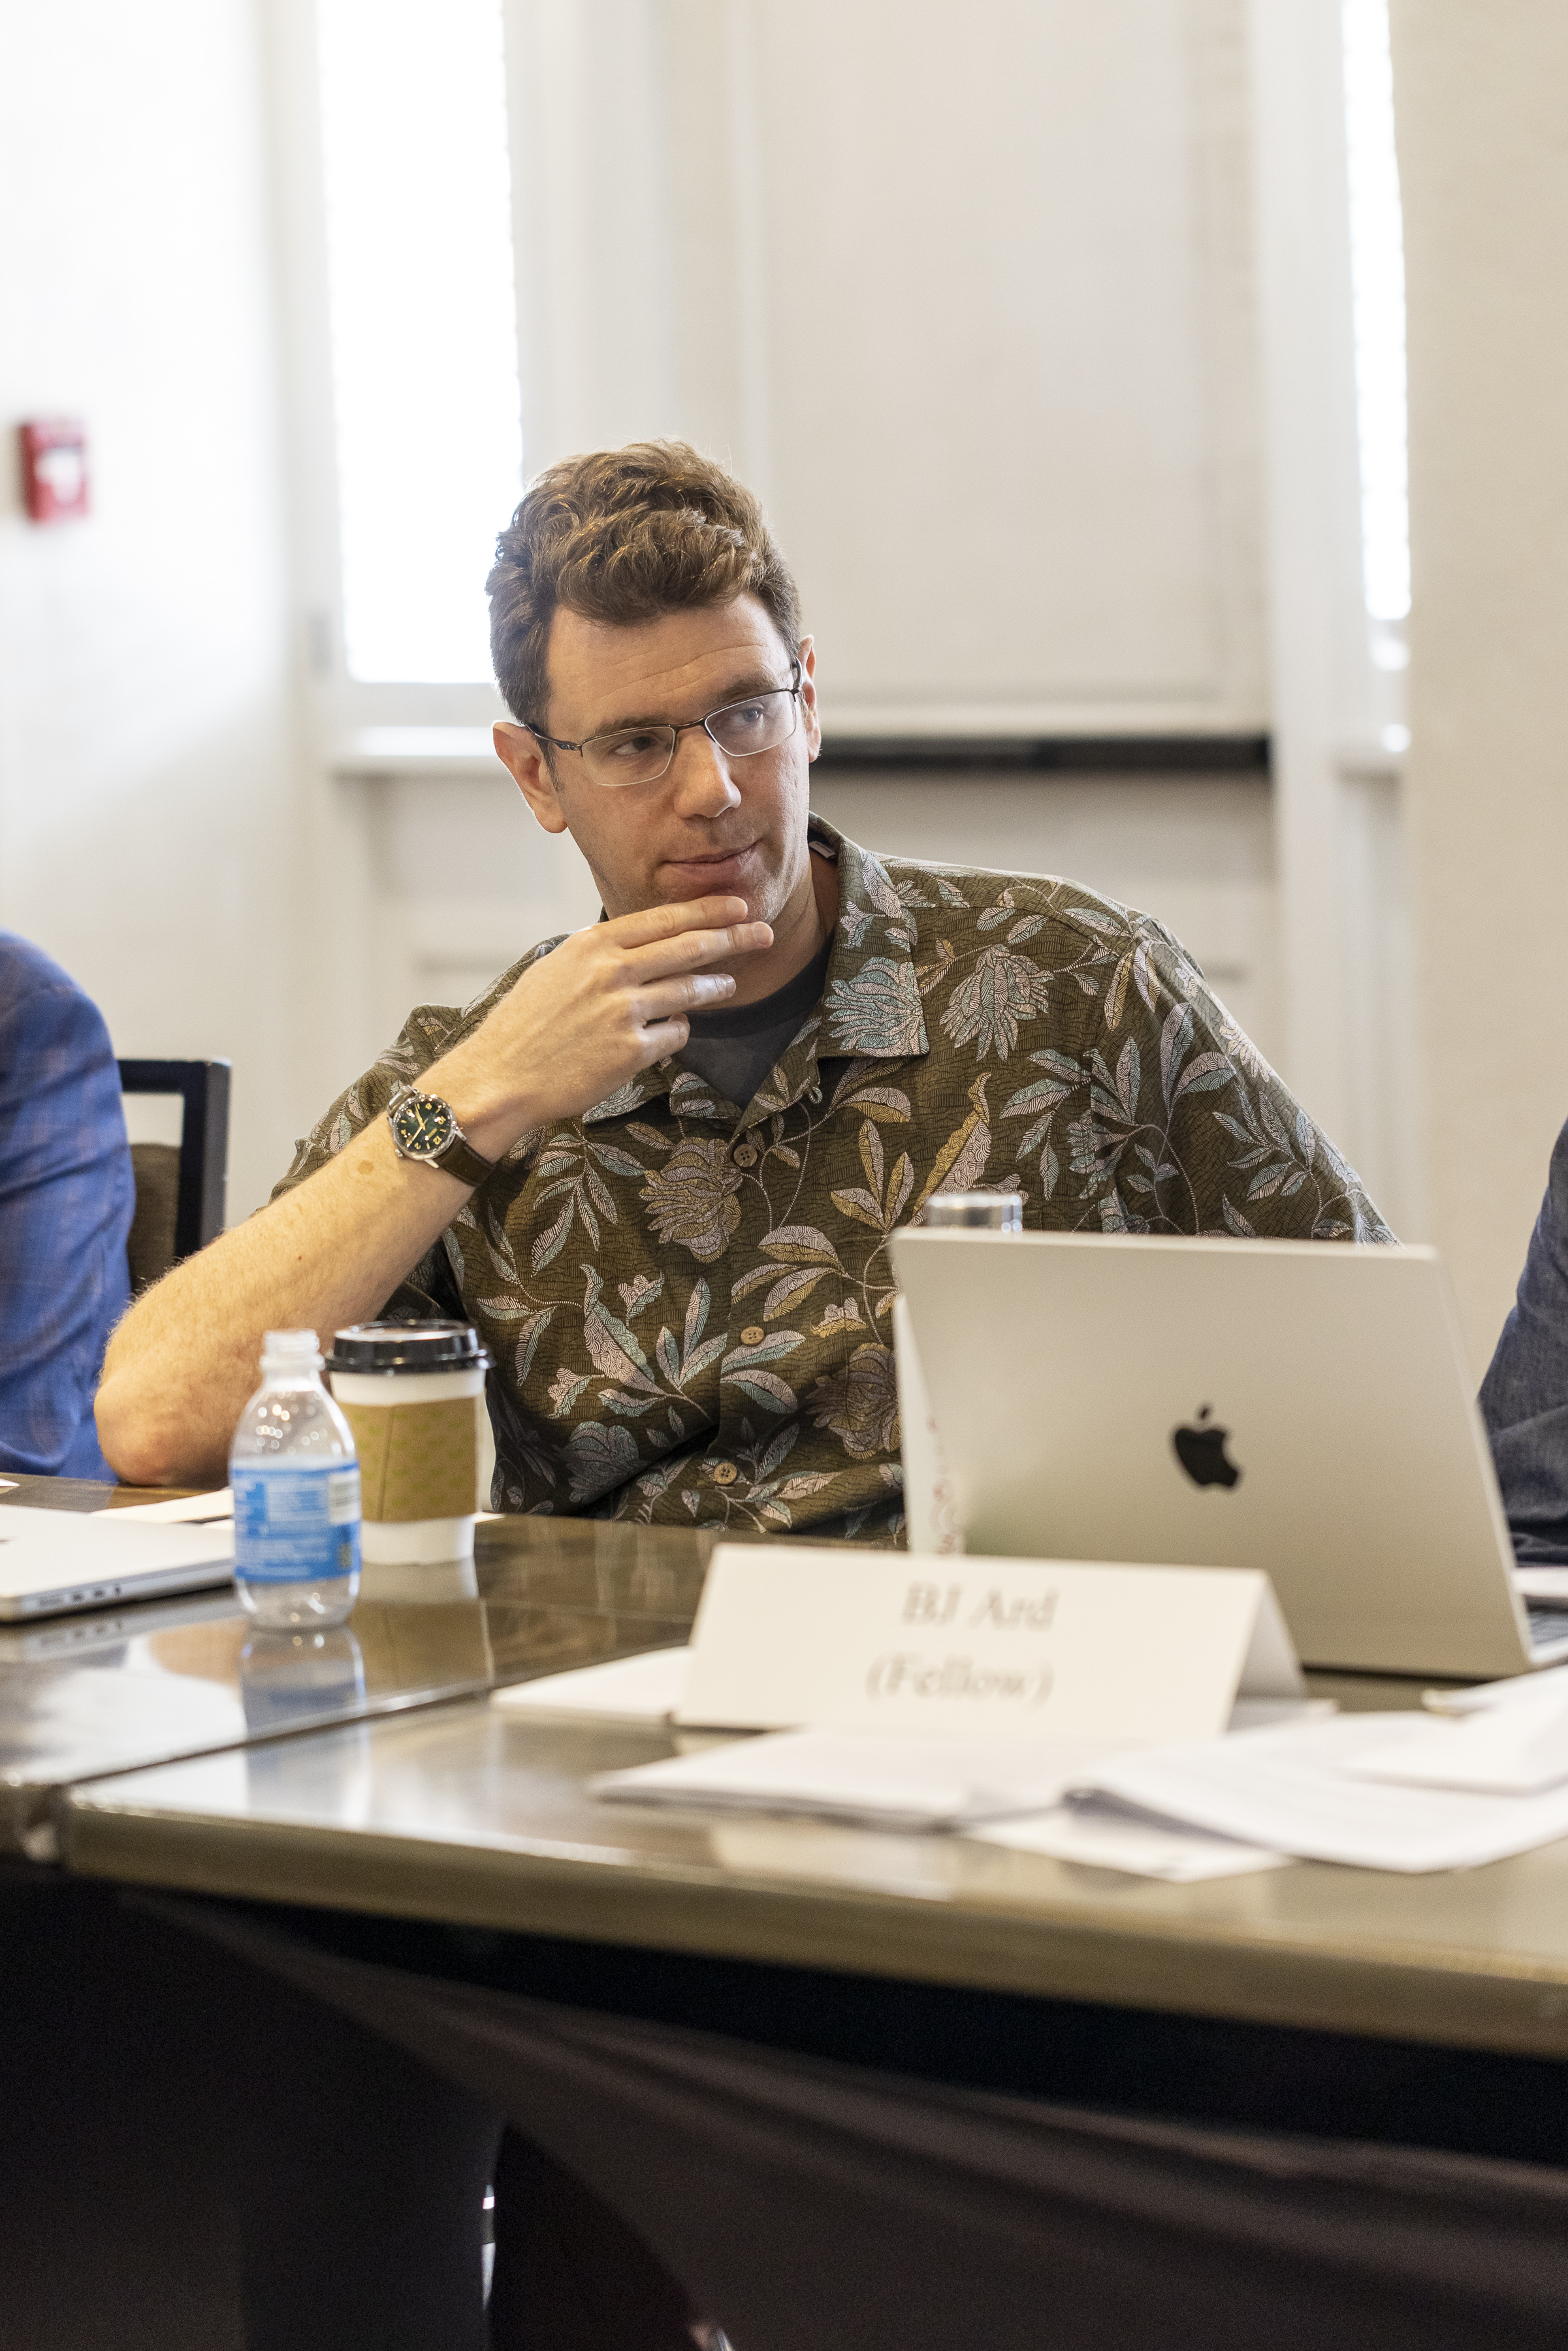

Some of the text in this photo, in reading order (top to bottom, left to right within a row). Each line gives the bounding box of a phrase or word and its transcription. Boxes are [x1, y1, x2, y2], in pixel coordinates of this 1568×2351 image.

[433, 1136, 442, 1145] 12
[902, 1579, 1059, 1631] BJ Ard
[865, 1650, 1055, 1711] (Fellow)
